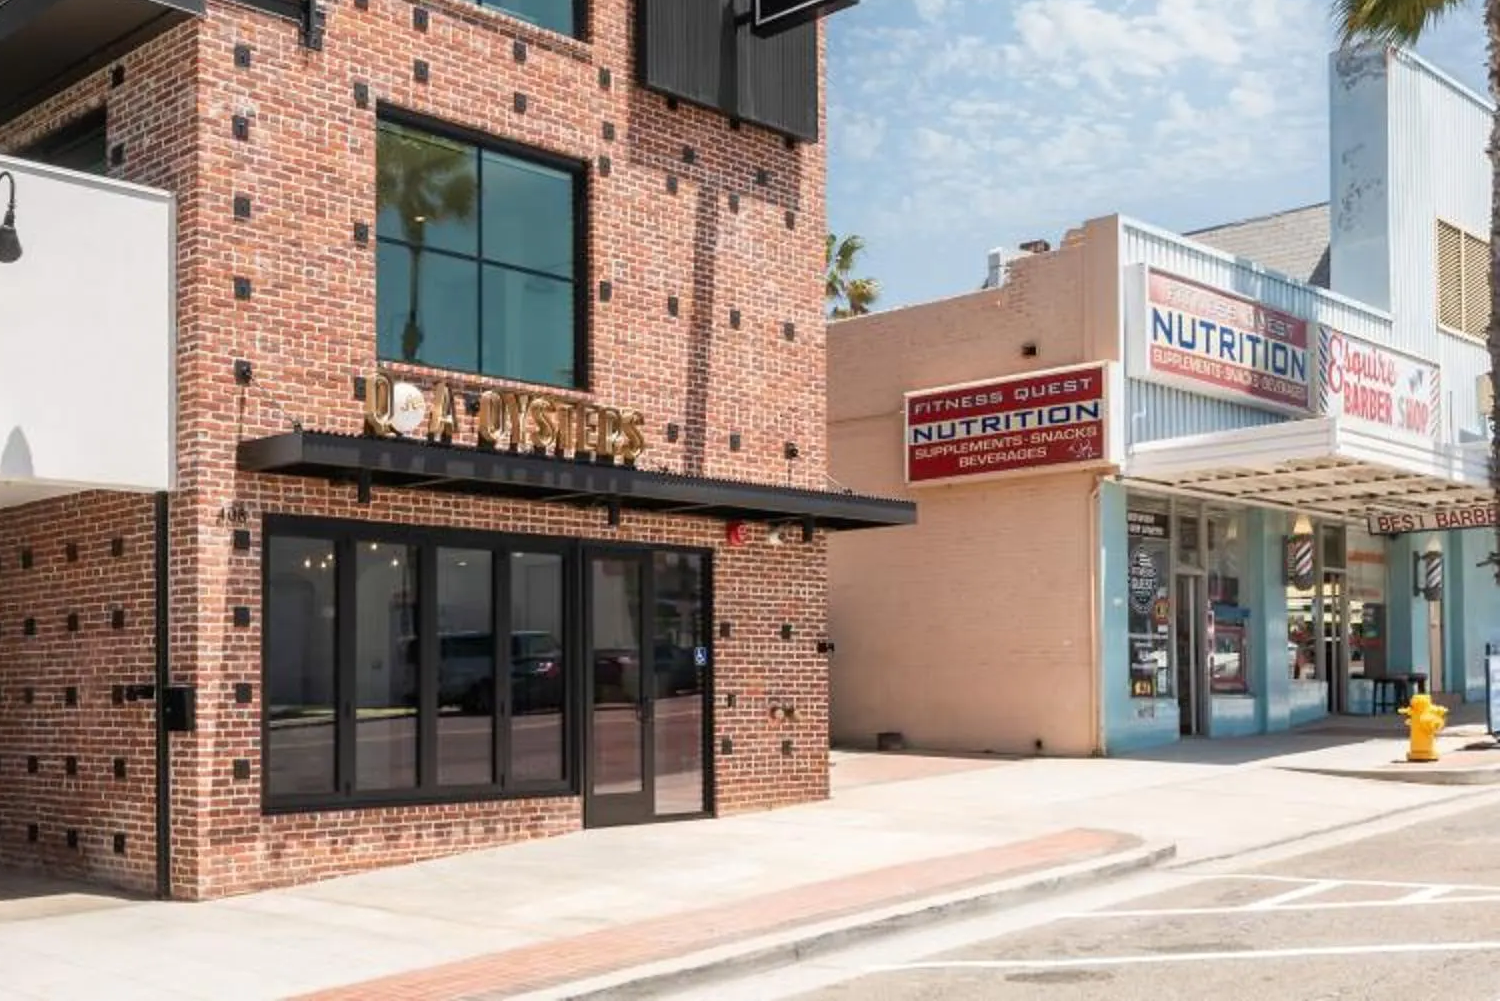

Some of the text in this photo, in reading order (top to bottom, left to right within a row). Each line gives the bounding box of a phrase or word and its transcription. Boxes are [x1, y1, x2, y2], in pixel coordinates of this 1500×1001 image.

[1152, 306, 1306, 381] NUTRITION
[914, 376, 1093, 415] FITNESS QUEST
[1343, 380, 1429, 434] BARBER SHOP
[478, 390, 645, 460] OYSTERS
[913, 400, 1100, 444] NUTRITION
[958, 446, 1047, 468] BEVERAGES
[1377, 513, 1425, 532] BEST
